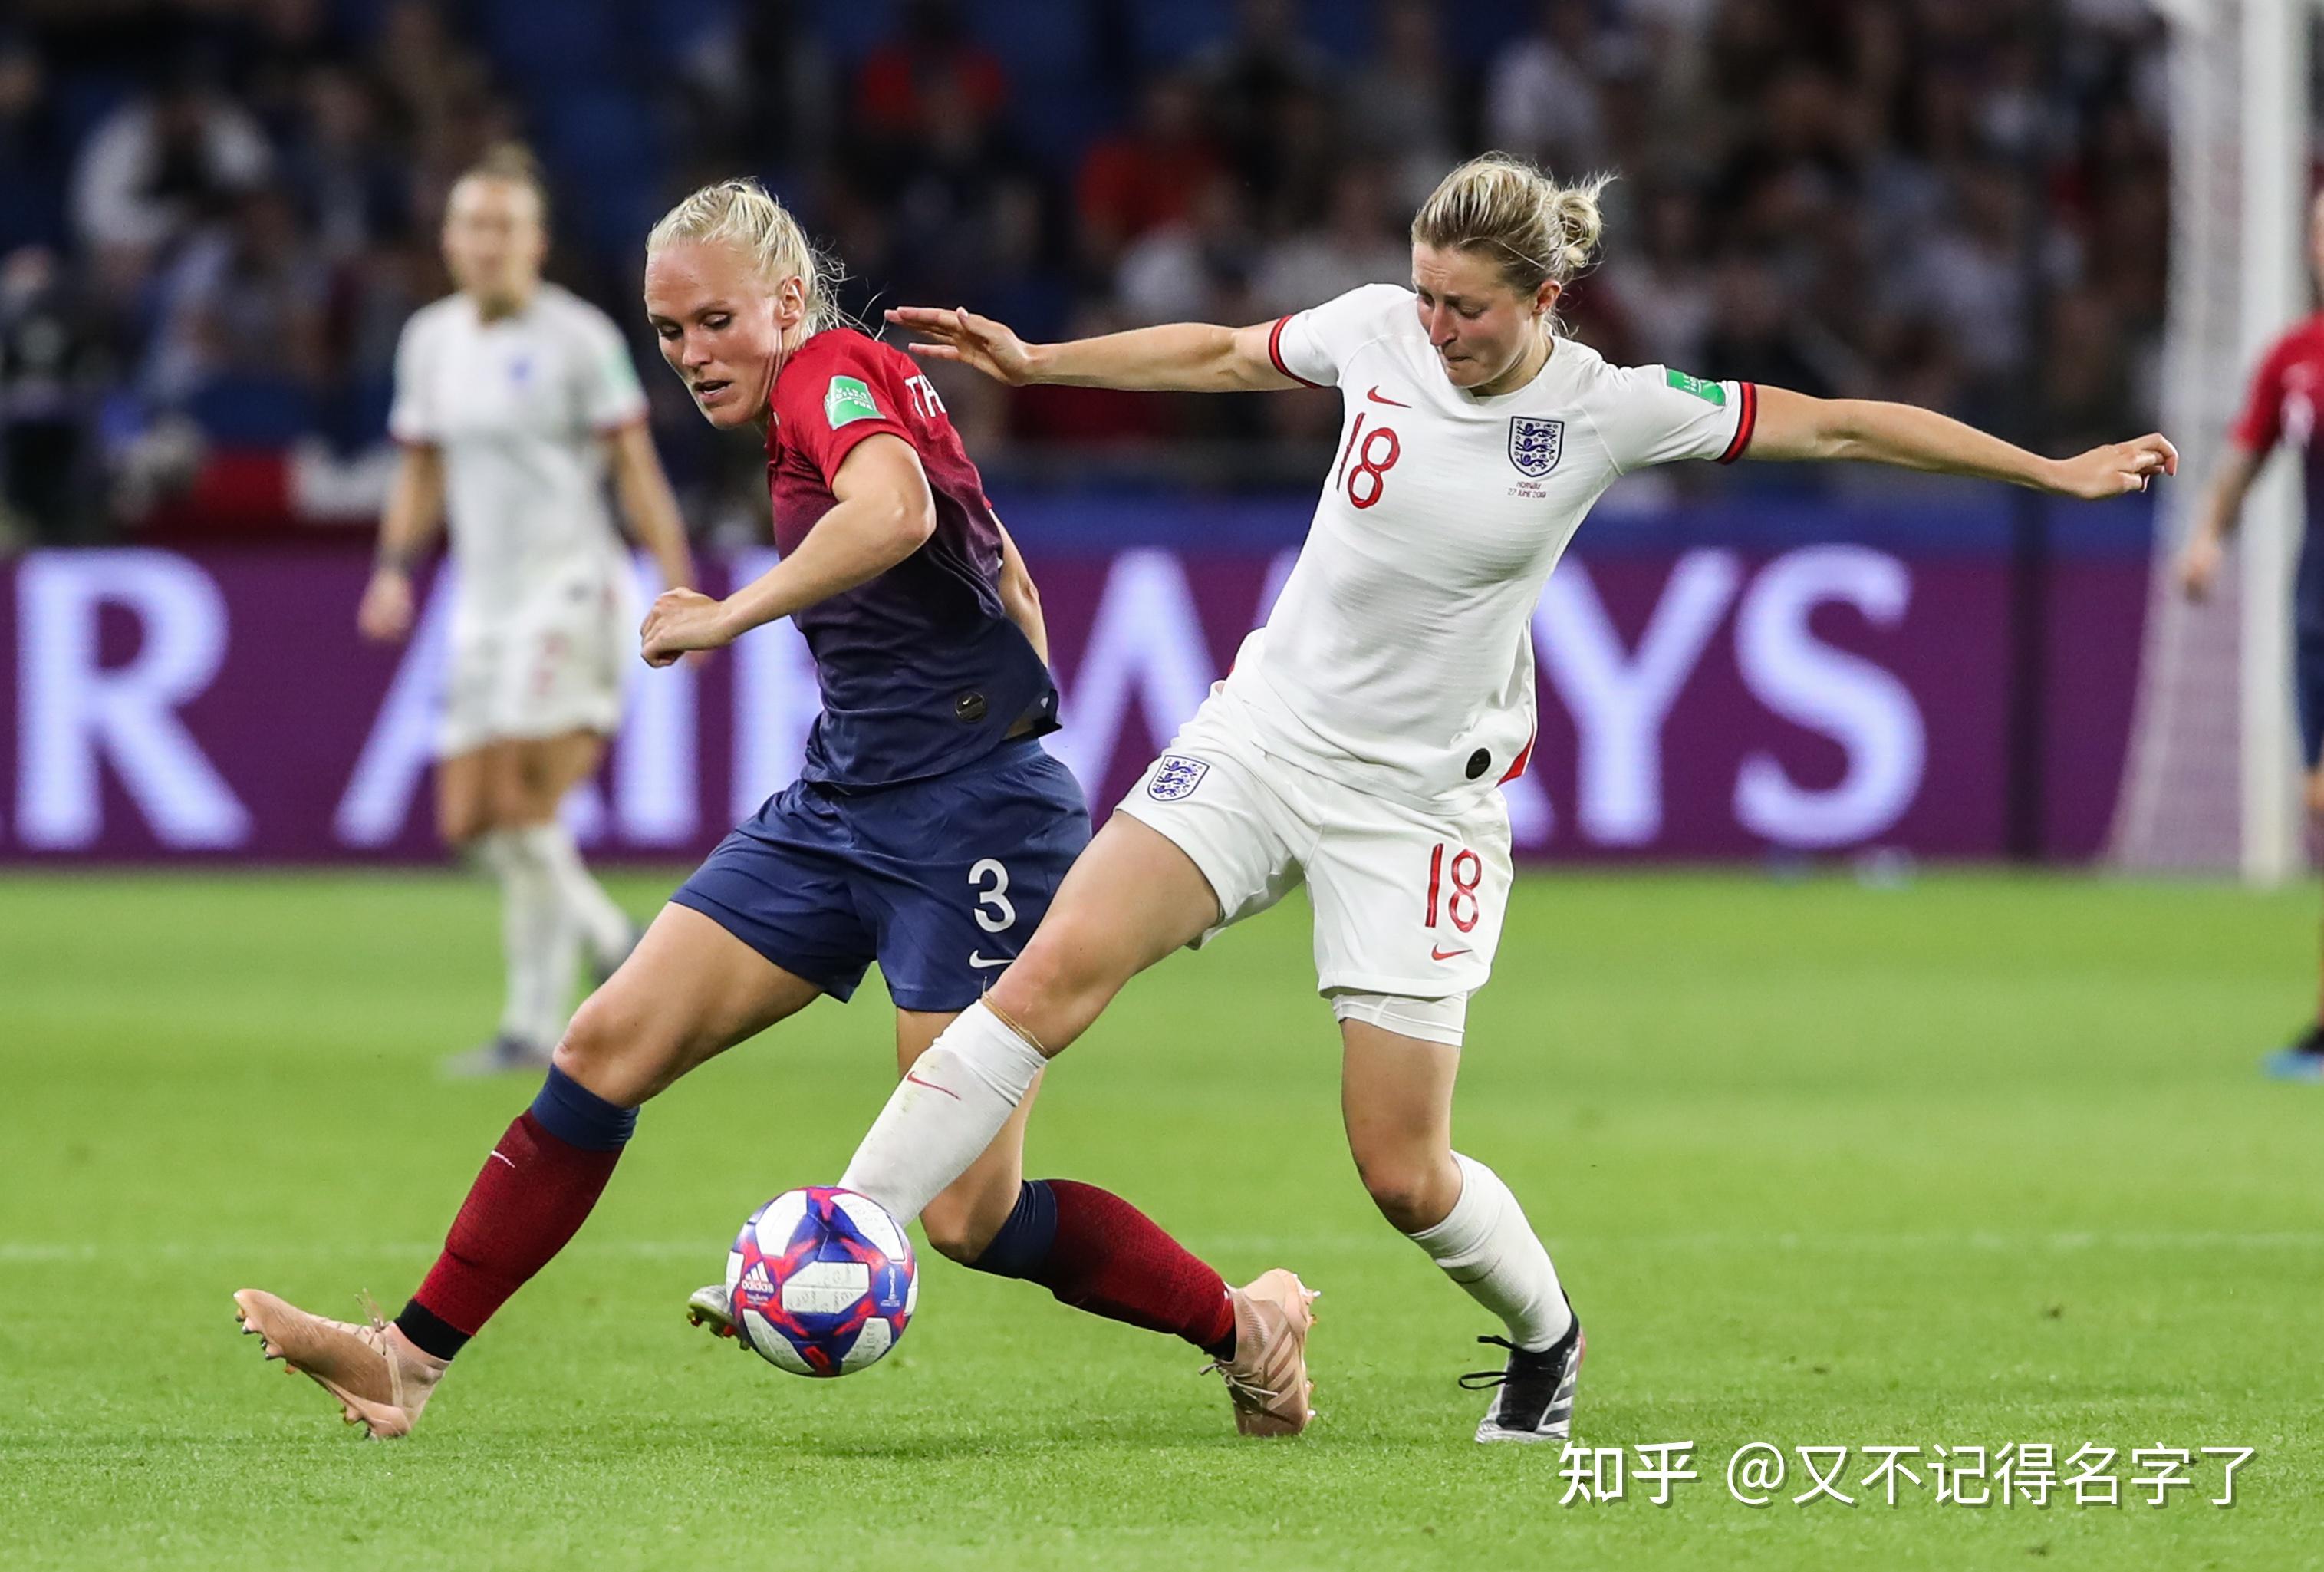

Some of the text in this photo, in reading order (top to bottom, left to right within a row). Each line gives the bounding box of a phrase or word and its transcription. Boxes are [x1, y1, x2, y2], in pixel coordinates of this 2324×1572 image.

[1336, 411, 1401, 509] 18
[968, 858, 1016, 932] 3
[1424, 842, 1482, 933] 18
[741, 1280, 775, 1294] adidas
